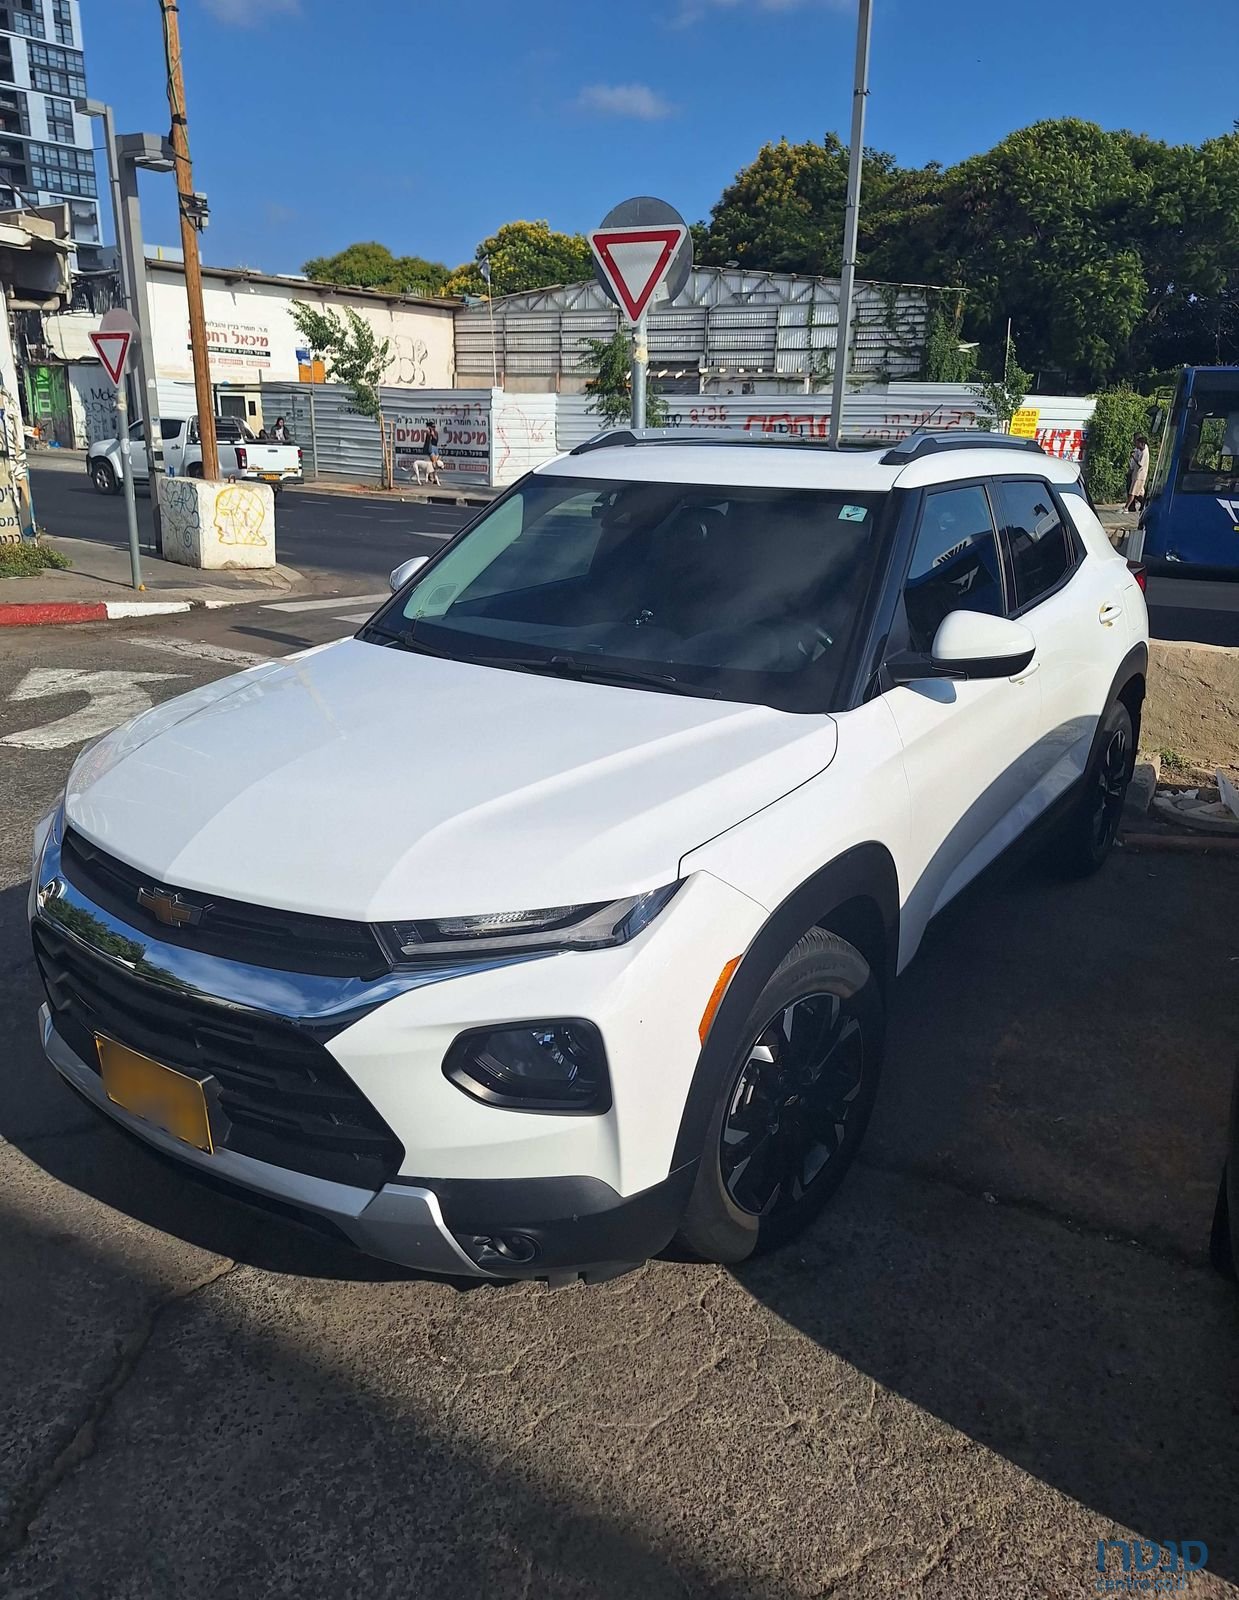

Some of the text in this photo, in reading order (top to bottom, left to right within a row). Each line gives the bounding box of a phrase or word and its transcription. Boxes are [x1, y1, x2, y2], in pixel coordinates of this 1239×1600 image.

[232, 330, 268, 346] מיכאל
[439, 418, 452, 426] בניין
[453, 418, 471, 426] חומרי
[396, 427, 487, 445] מיכאל חמים
